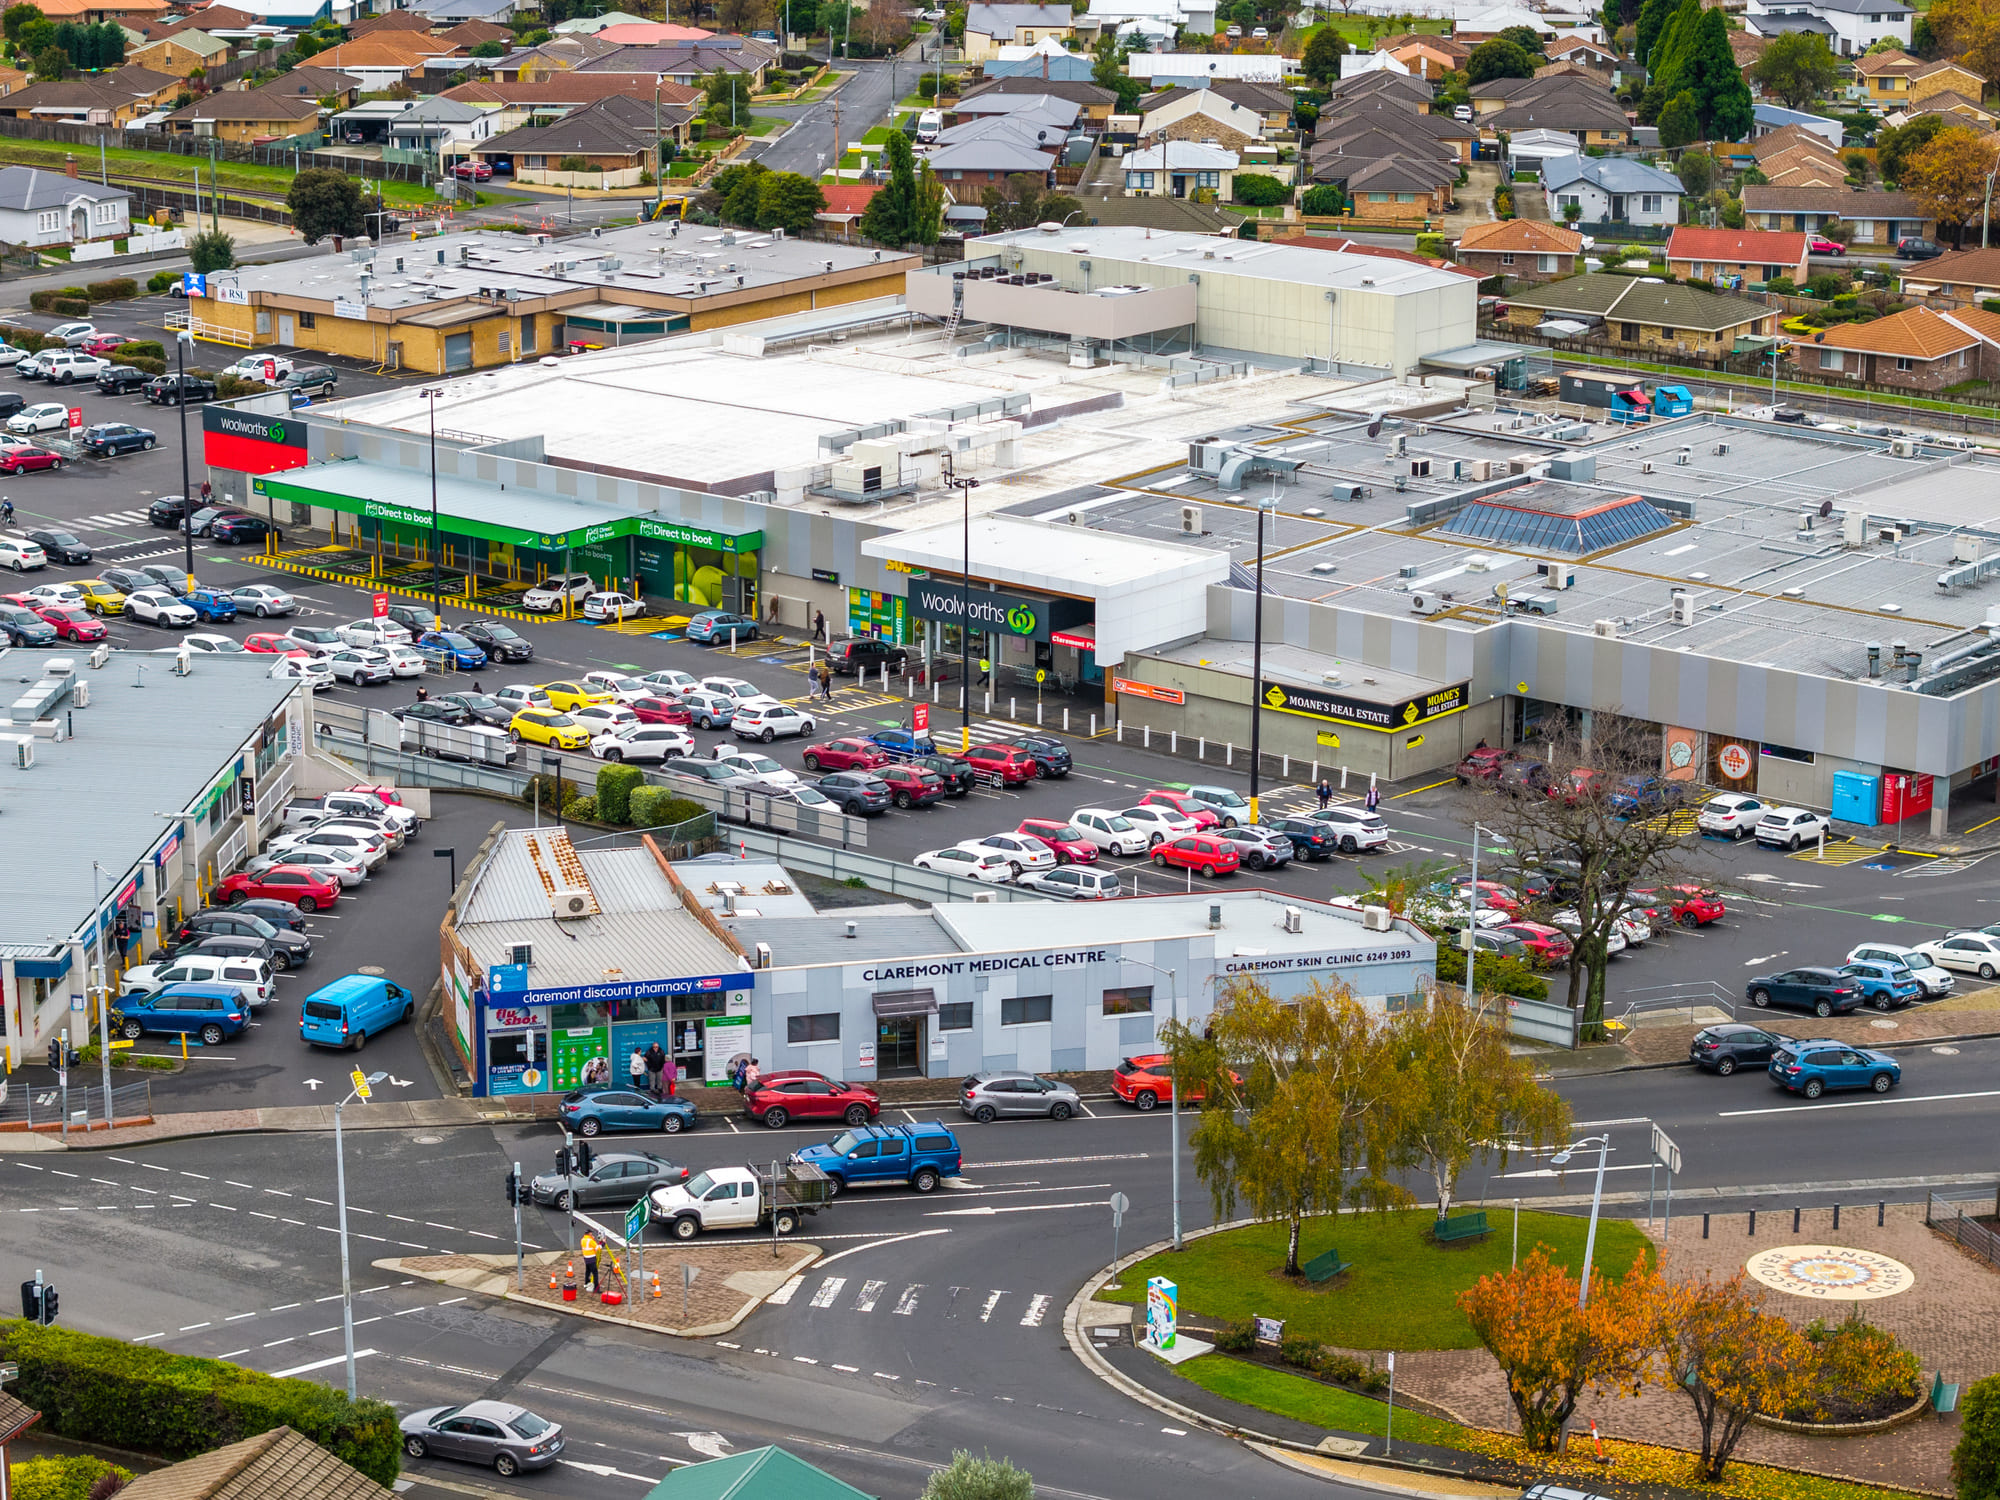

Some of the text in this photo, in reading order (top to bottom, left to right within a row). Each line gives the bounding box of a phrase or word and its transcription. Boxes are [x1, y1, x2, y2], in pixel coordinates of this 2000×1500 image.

[229, 289, 246, 300] RSL
[221, 417, 268, 437] Woolworths
[378, 506, 432, 525] Direct to boot
[653, 524, 713, 546] Direct to boot
[585, 550, 592, 558] to
[921, 591, 1005, 624] Woolworths
[1051, 634, 1085, 646] Claremont
[1427, 687, 1460, 708] MOANE'S
[1427, 698, 1460, 716] REAL ESTATE
[1289, 695, 1390, 724] MOANE'S REAL ESTATE
[863, 950, 1106, 981] CLAREMONT MEDICAL CENTRE
[1225, 950, 1411, 973] CLAREMONT SKIN CLINIC 6249 3093
[523, 988, 581, 1004] claremont
[583, 985, 632, 999] discount
[634, 981, 693, 998] pharmacy
[496, 1008, 516, 1019] flu
[504, 1014, 538, 1026] shot
[1759, 1253, 1827, 1296] DISCOVER
[1824, 1249, 1903, 1293] CLAREMONT
